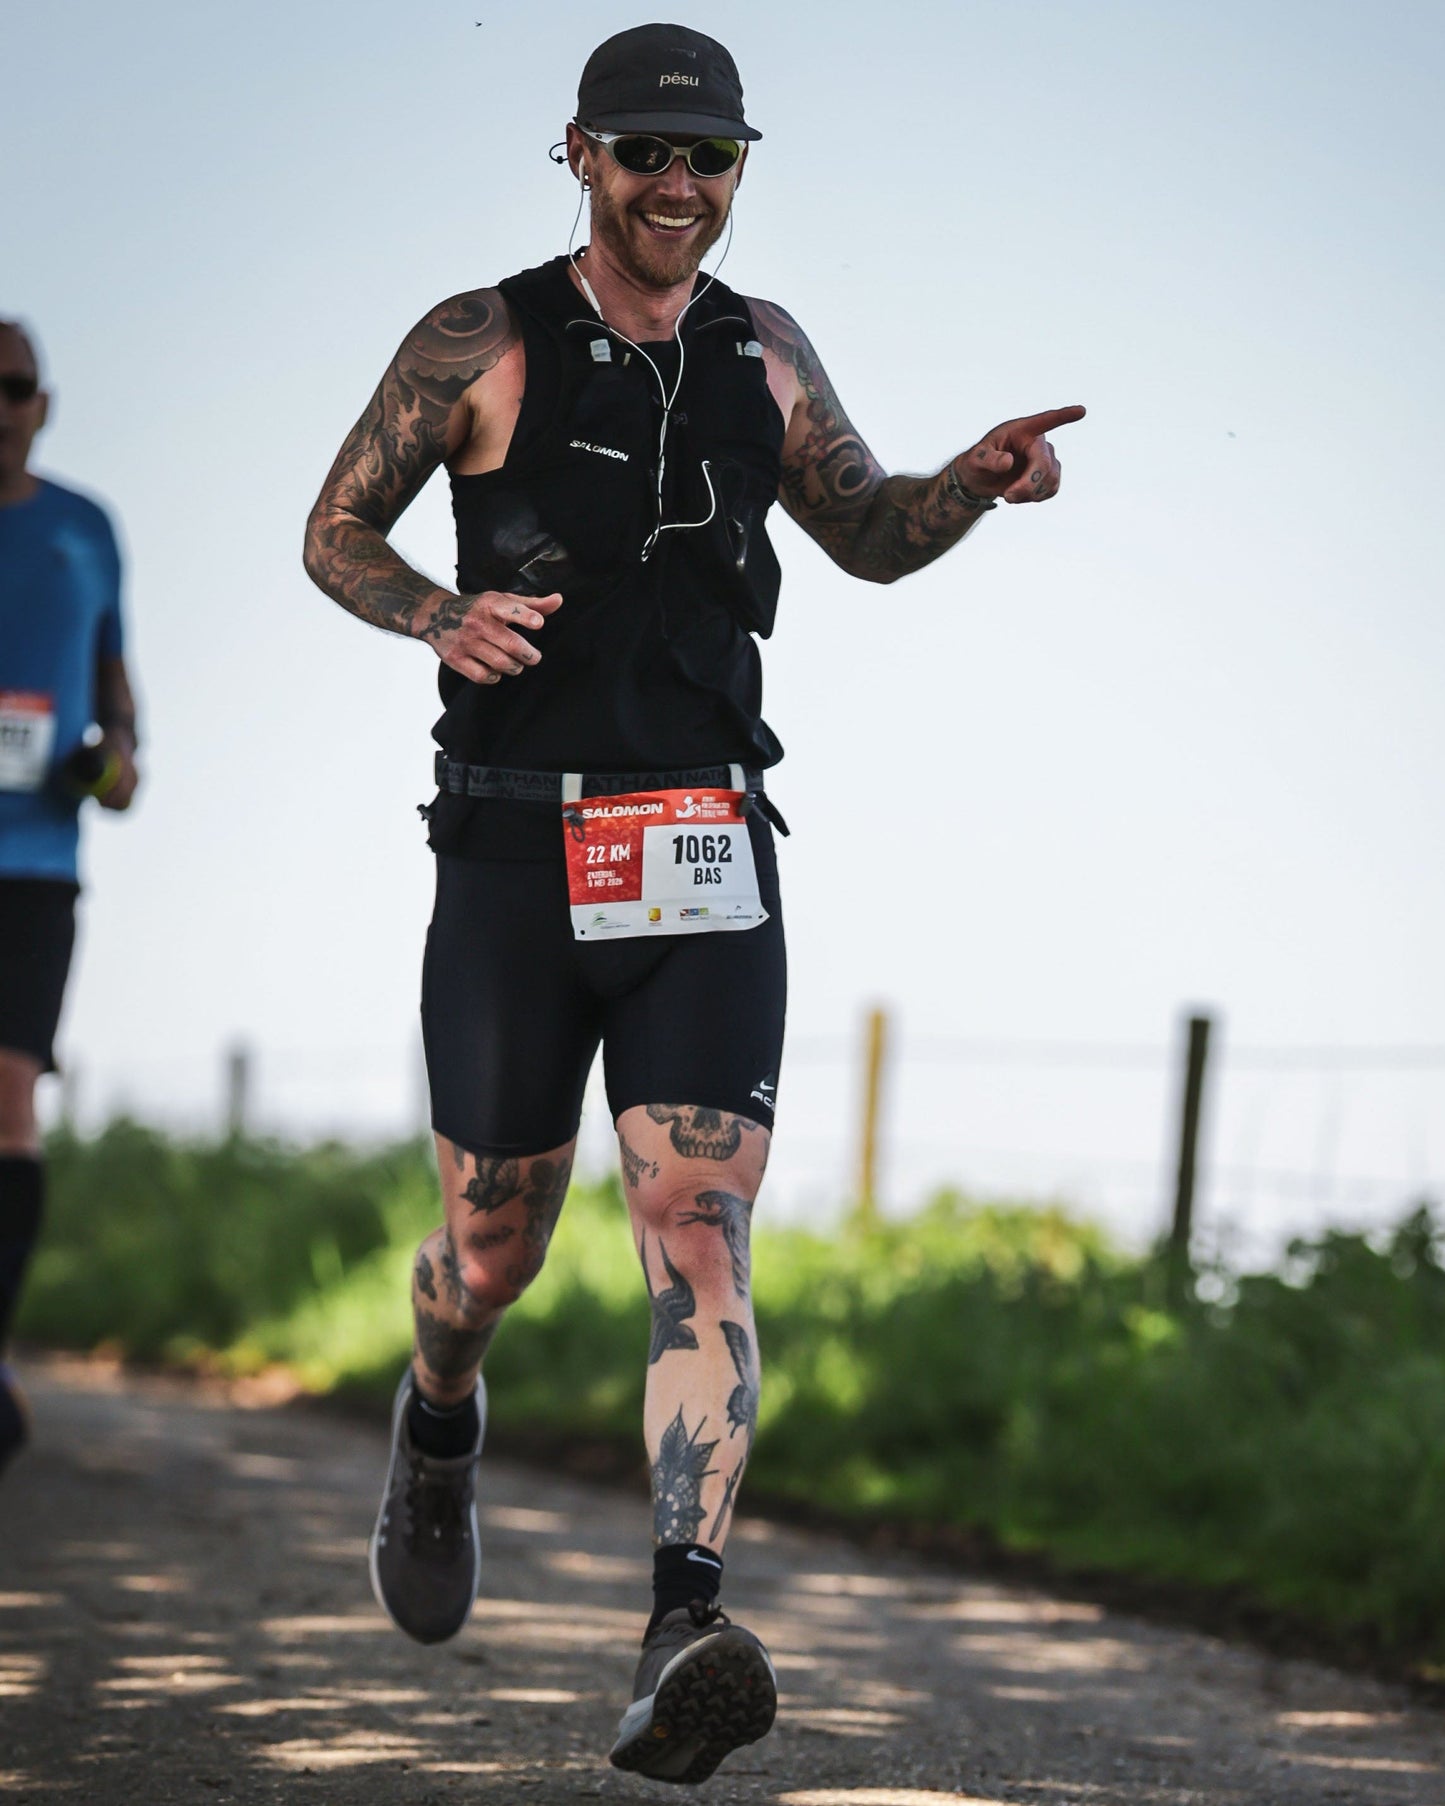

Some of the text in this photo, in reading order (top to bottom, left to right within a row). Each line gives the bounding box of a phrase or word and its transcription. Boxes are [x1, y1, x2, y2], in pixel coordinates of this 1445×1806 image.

[658, 71, 700, 88] pēsu
[569, 439, 630, 462] SALOMON
[584, 771, 683, 793] ATHAN
[582, 802, 664, 819] SALOMON
[586, 844, 631, 864] 22 KM
[672, 834, 733, 864] 1062
[693, 867, 722, 885] BAS
